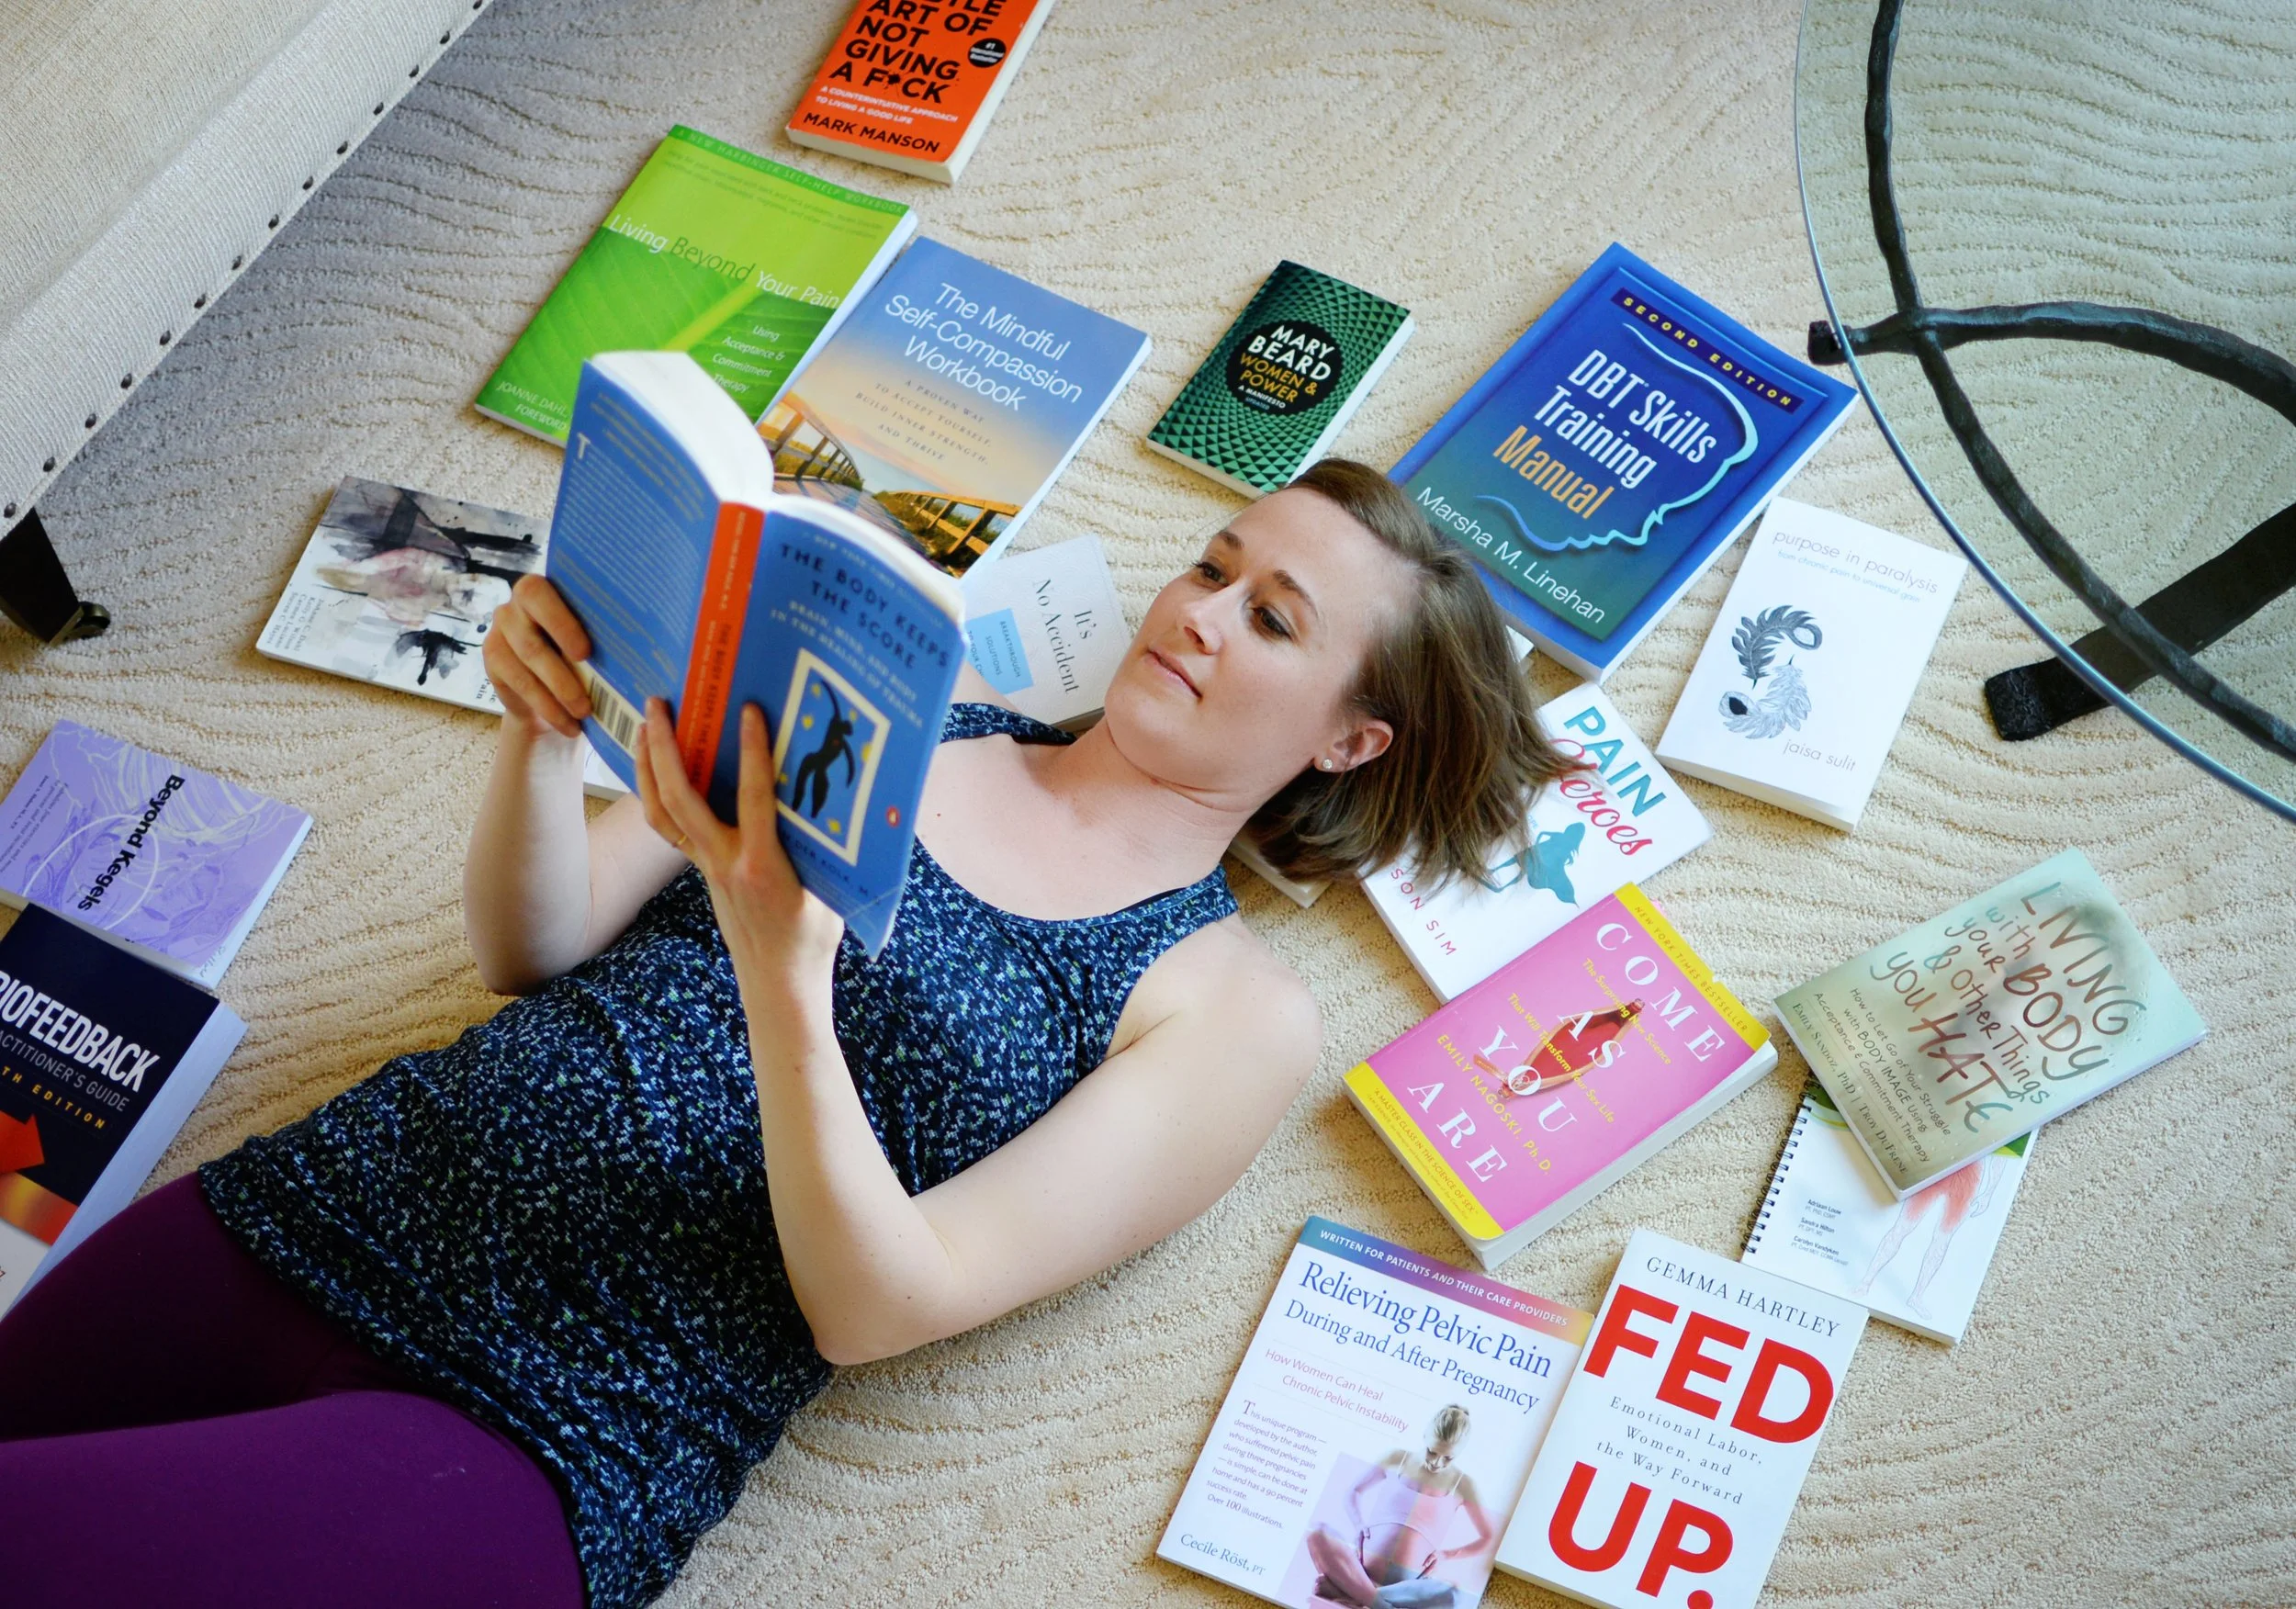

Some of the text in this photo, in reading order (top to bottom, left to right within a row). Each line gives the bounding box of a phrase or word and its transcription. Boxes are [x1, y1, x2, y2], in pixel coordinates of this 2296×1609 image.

[856, 16, 929, 48] NOT
[867, 0, 939, 25] ART
[944, 13, 993, 36] OF
[829, 61, 852, 83] A
[845, 39, 961, 81] GIVING
[804, 112, 940, 152] MARK MANSON
[828, 87, 959, 123] COUNTERINTUITIVE APPROACH
[608, 213, 840, 309] Living Beyond Your Pain
[722, 336, 775, 359] Acceptance
[884, 294, 1083, 404] Self-Compassion
[934, 282, 1072, 362] The Mindful
[1270, 324, 1335, 360] MARY
[1623, 297, 1791, 406] SECOND EDITION
[713, 353, 772, 377] Commitment
[904, 334, 1027, 412] Workbook
[1240, 352, 1319, 396] WOMEN &
[1240, 369, 1299, 403] POWER
[1247, 334, 1332, 381] BEARD
[892, 392, 934, 416] ACCEPT
[917, 386, 959, 411] PROVEN
[1246, 387, 1286, 410] MANIFESTO
[1628, 389, 1717, 463] Skills
[1534, 385, 1658, 489] Training
[1492, 424, 1615, 520] Manual
[1415, 486, 1606, 624] Marsha M. Linehan
[1772, 531, 1939, 594] purpose in paralysis
[1863, 578, 1900, 595] universal
[781, 544, 825, 573] THE
[835, 568, 888, 613] BODY
[895, 612, 950, 669] KEEPS
[811, 580, 917, 669] THE SCORE
[1032, 579, 1079, 694] No Accident
[1074, 609, 1097, 640] It's
[985, 635, 1003, 676] SOLUTIONS
[998, 620, 1021, 678] BREAKTHROUGH
[1564, 705, 1667, 817] PAIN
[1783, 738, 1857, 772] jaisa sulit
[76, 774, 186, 911] Beyond Kegels
[1425, 919, 1458, 956] SIM
[1985, 906, 2036, 961] with
[2020, 882, 2147, 1036] LIVING
[1582, 958, 1671, 1065] The Surprising New Science
[1596, 922, 1726, 1063] COME
[1653, 927, 1749, 1032] YORK TIMES BESTSELLER
[1436, 1034, 1474, 1074] EMILY
[1538, 1030, 1571, 1073] Transform
[1558, 1010, 1627, 1069] AS
[2003, 962, 2110, 1081] BODY
[1479, 1025, 1579, 1132] YOU
[1792, 1002, 1879, 1131] EMILY PhD TROY
[1814, 992, 1931, 1165] Acceptance Commitment Therapy
[1851, 987, 1952, 1137] How Let Your Struggle
[1857, 1030, 1930, 1134] BODY IMAGE Using
[1908, 1012, 2015, 1134] HATE
[1992, 1024, 2051, 1105] Things
[31, 1084, 106, 1130] EDITION
[85, 1080, 129, 1114] GUIDE
[1399, 1118, 1458, 1192] CLASS SCIENCE
[1407, 1081, 1508, 1184] ARE
[1320, 1229, 1569, 1327] WRITTEN FOR PATIENTS AND THEIR CARE PROVIDERS
[1646, 1256, 1841, 1338] GEMMA HARTLEY
[1298, 1261, 1553, 1379] Relieving Pelvic Pain
[1265, 1347, 1385, 1402] How Women Can Heal
[1284, 1299, 1542, 1415] During and After Pregnancy
[1583, 1283, 1835, 1444] FED
[1233, 1418, 1270, 1437] developed
[1261, 1415, 1318, 1442] unique program
[1281, 1374, 1411, 1435] Chronic Pelvic Instability
[1609, 1395, 1763, 1466] Emotional Labor,
[1222, 1442, 1308, 1481] during pregnancies
[1595, 1439, 1744, 1506] the Way Forward
[1626, 1424, 1733, 1477] Women, and
[1180, 1533, 1251, 1571] Cecile Röst,
[1548, 1460, 1735, 1609] UP.
